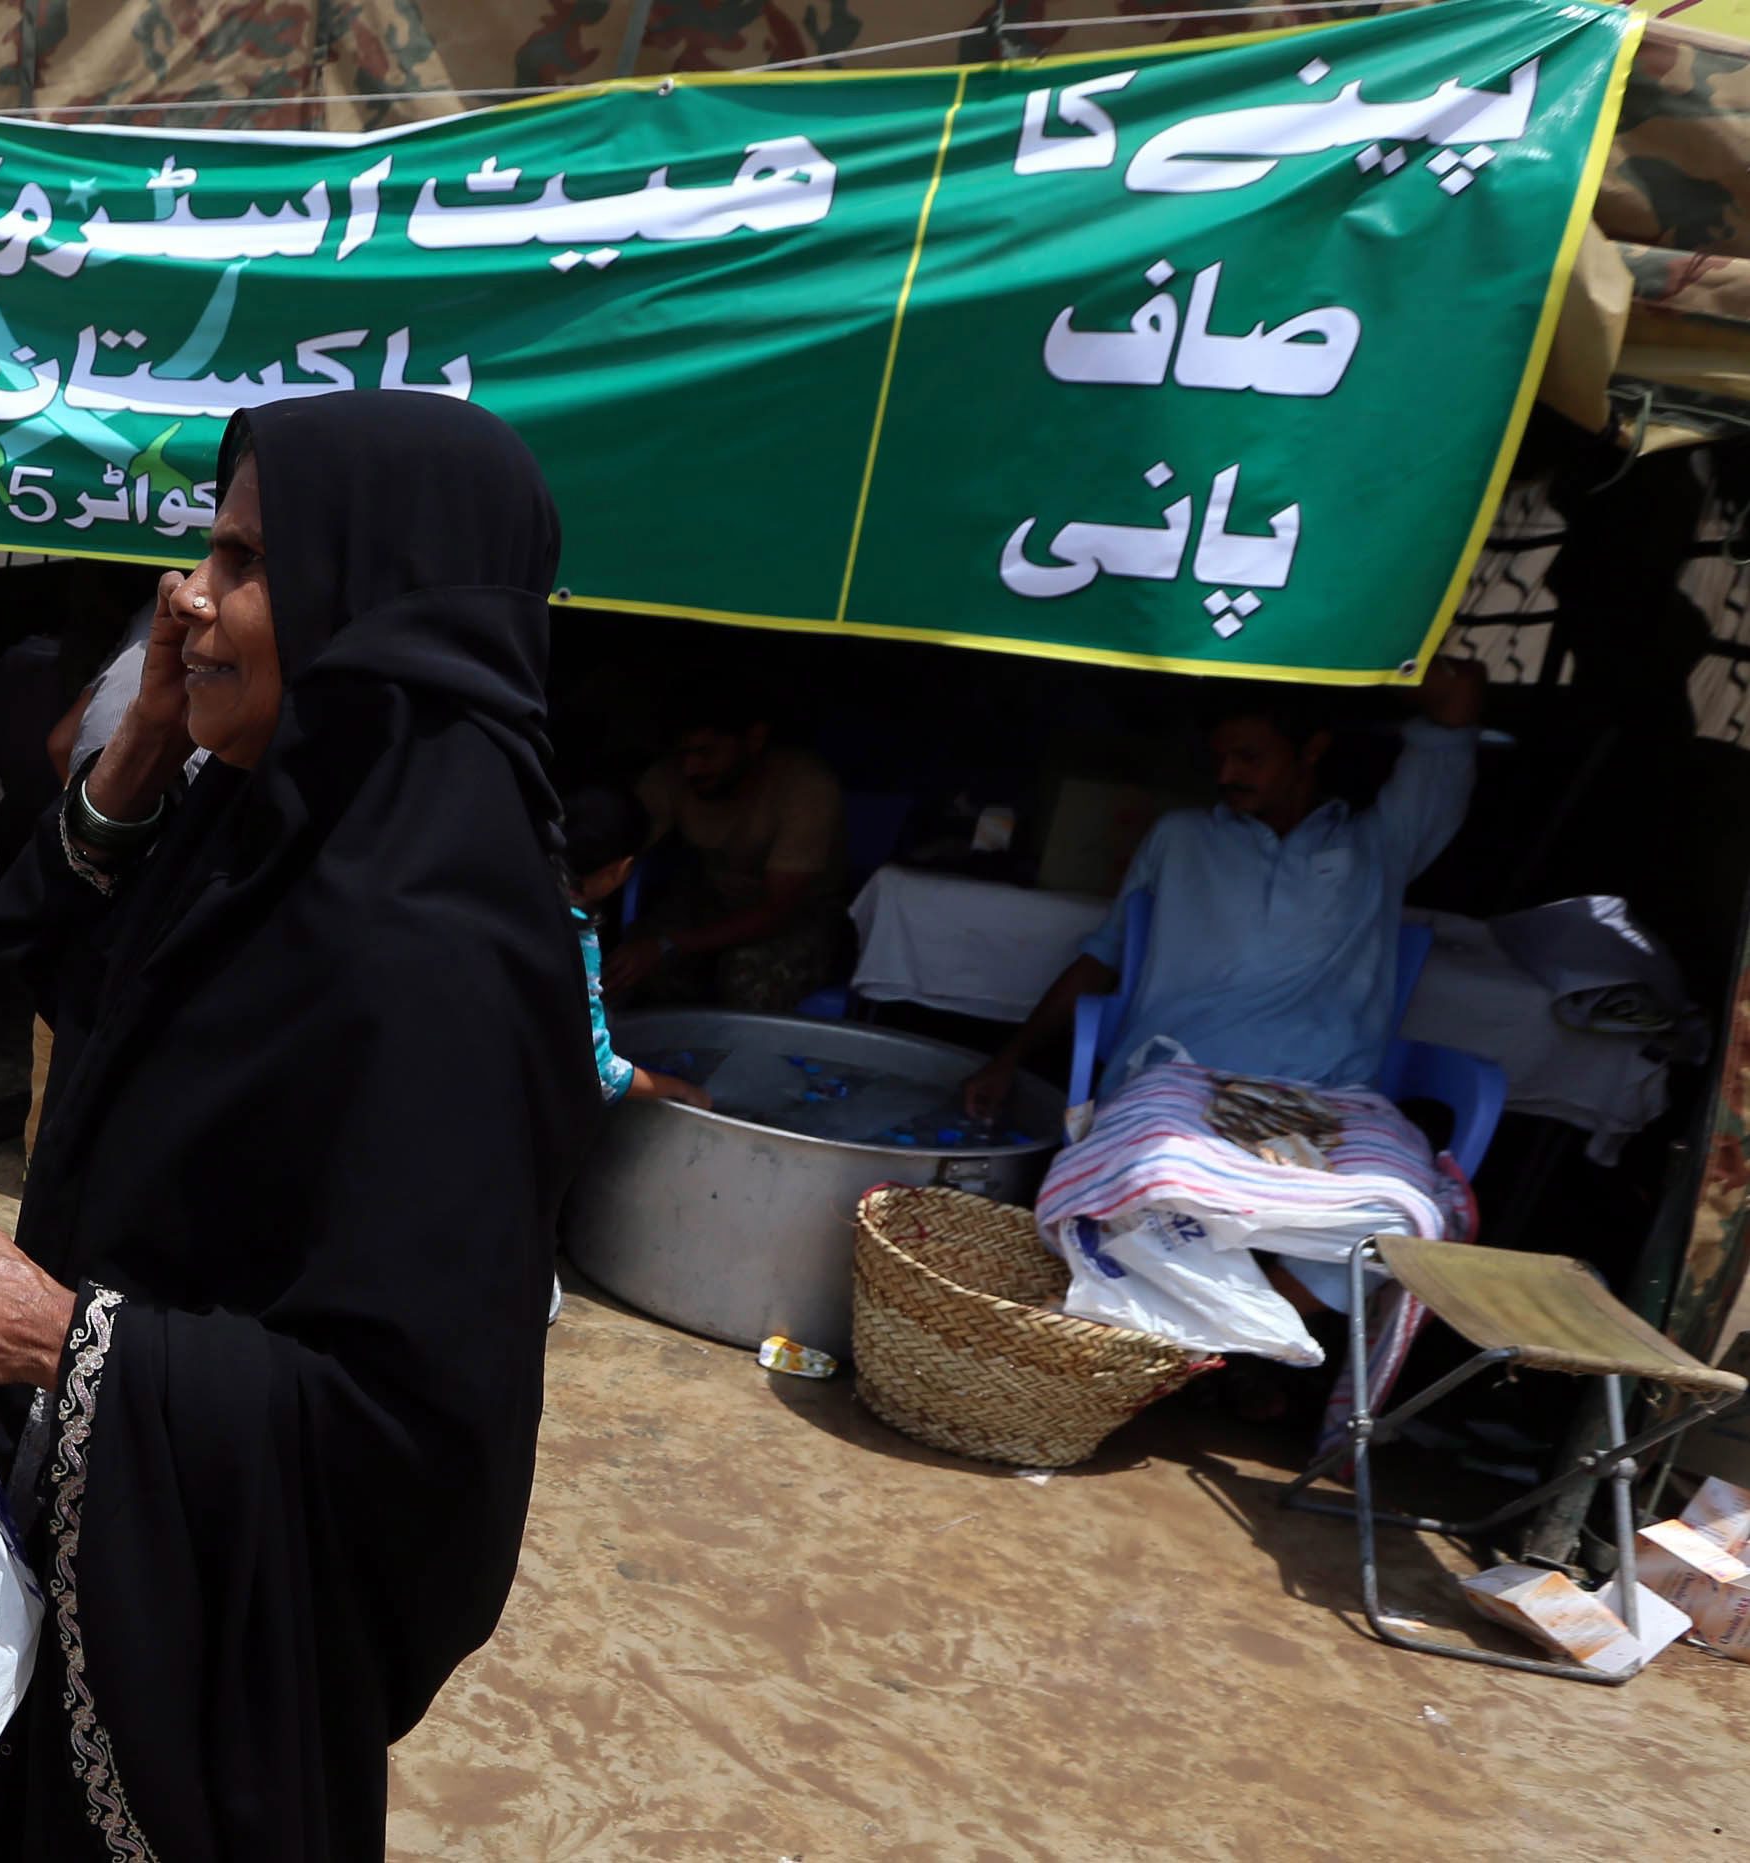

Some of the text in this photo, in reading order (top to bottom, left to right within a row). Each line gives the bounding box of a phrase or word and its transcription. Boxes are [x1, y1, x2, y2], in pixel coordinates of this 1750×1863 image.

[1012, 55, 1543, 196] پینے کا
[1043, 257, 1363, 397] صاف
[8, 464, 56, 523] 5
[999, 460, 1301, 639] پانی
